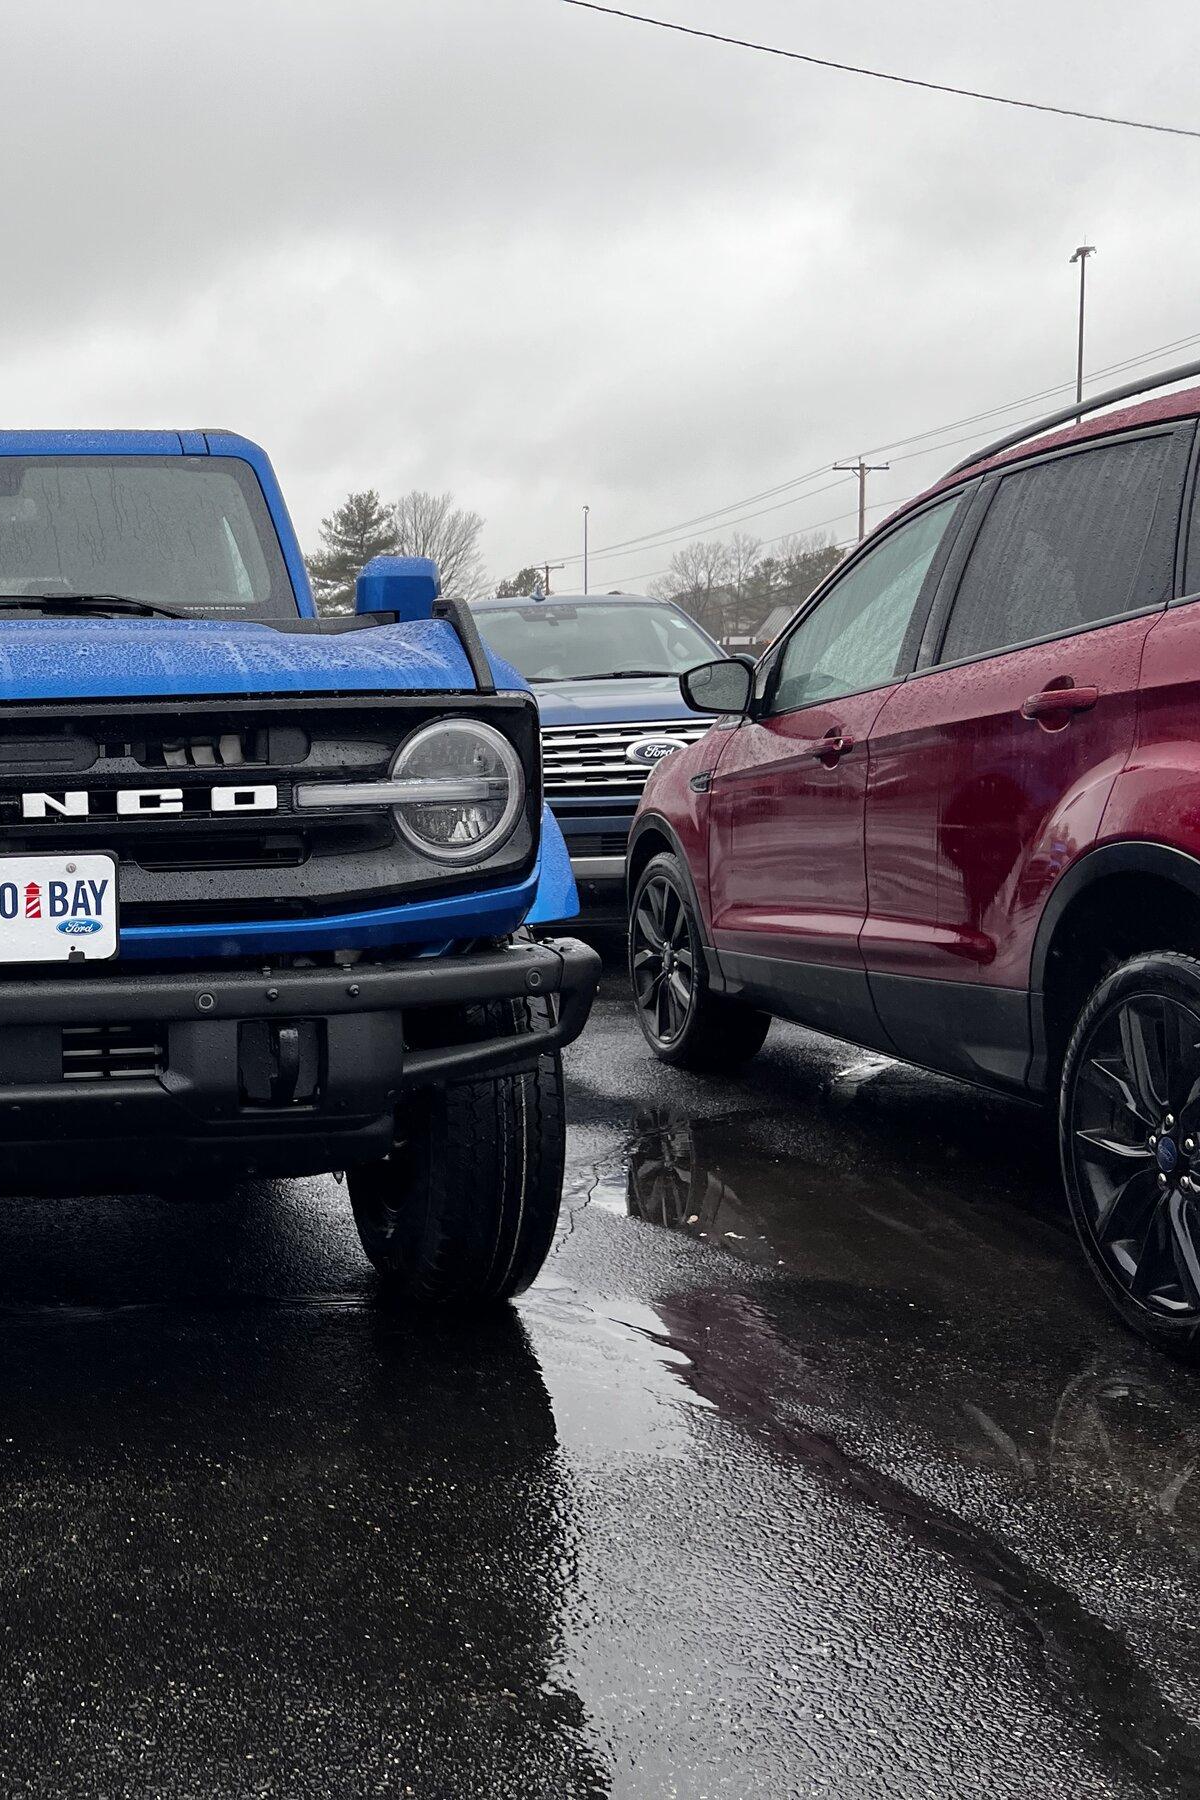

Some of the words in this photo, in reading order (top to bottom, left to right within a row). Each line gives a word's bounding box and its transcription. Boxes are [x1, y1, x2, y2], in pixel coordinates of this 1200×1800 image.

[644, 744, 674, 758] Ford
[49, 879, 109, 917] BAY
[65, 920, 94, 933] Ford
